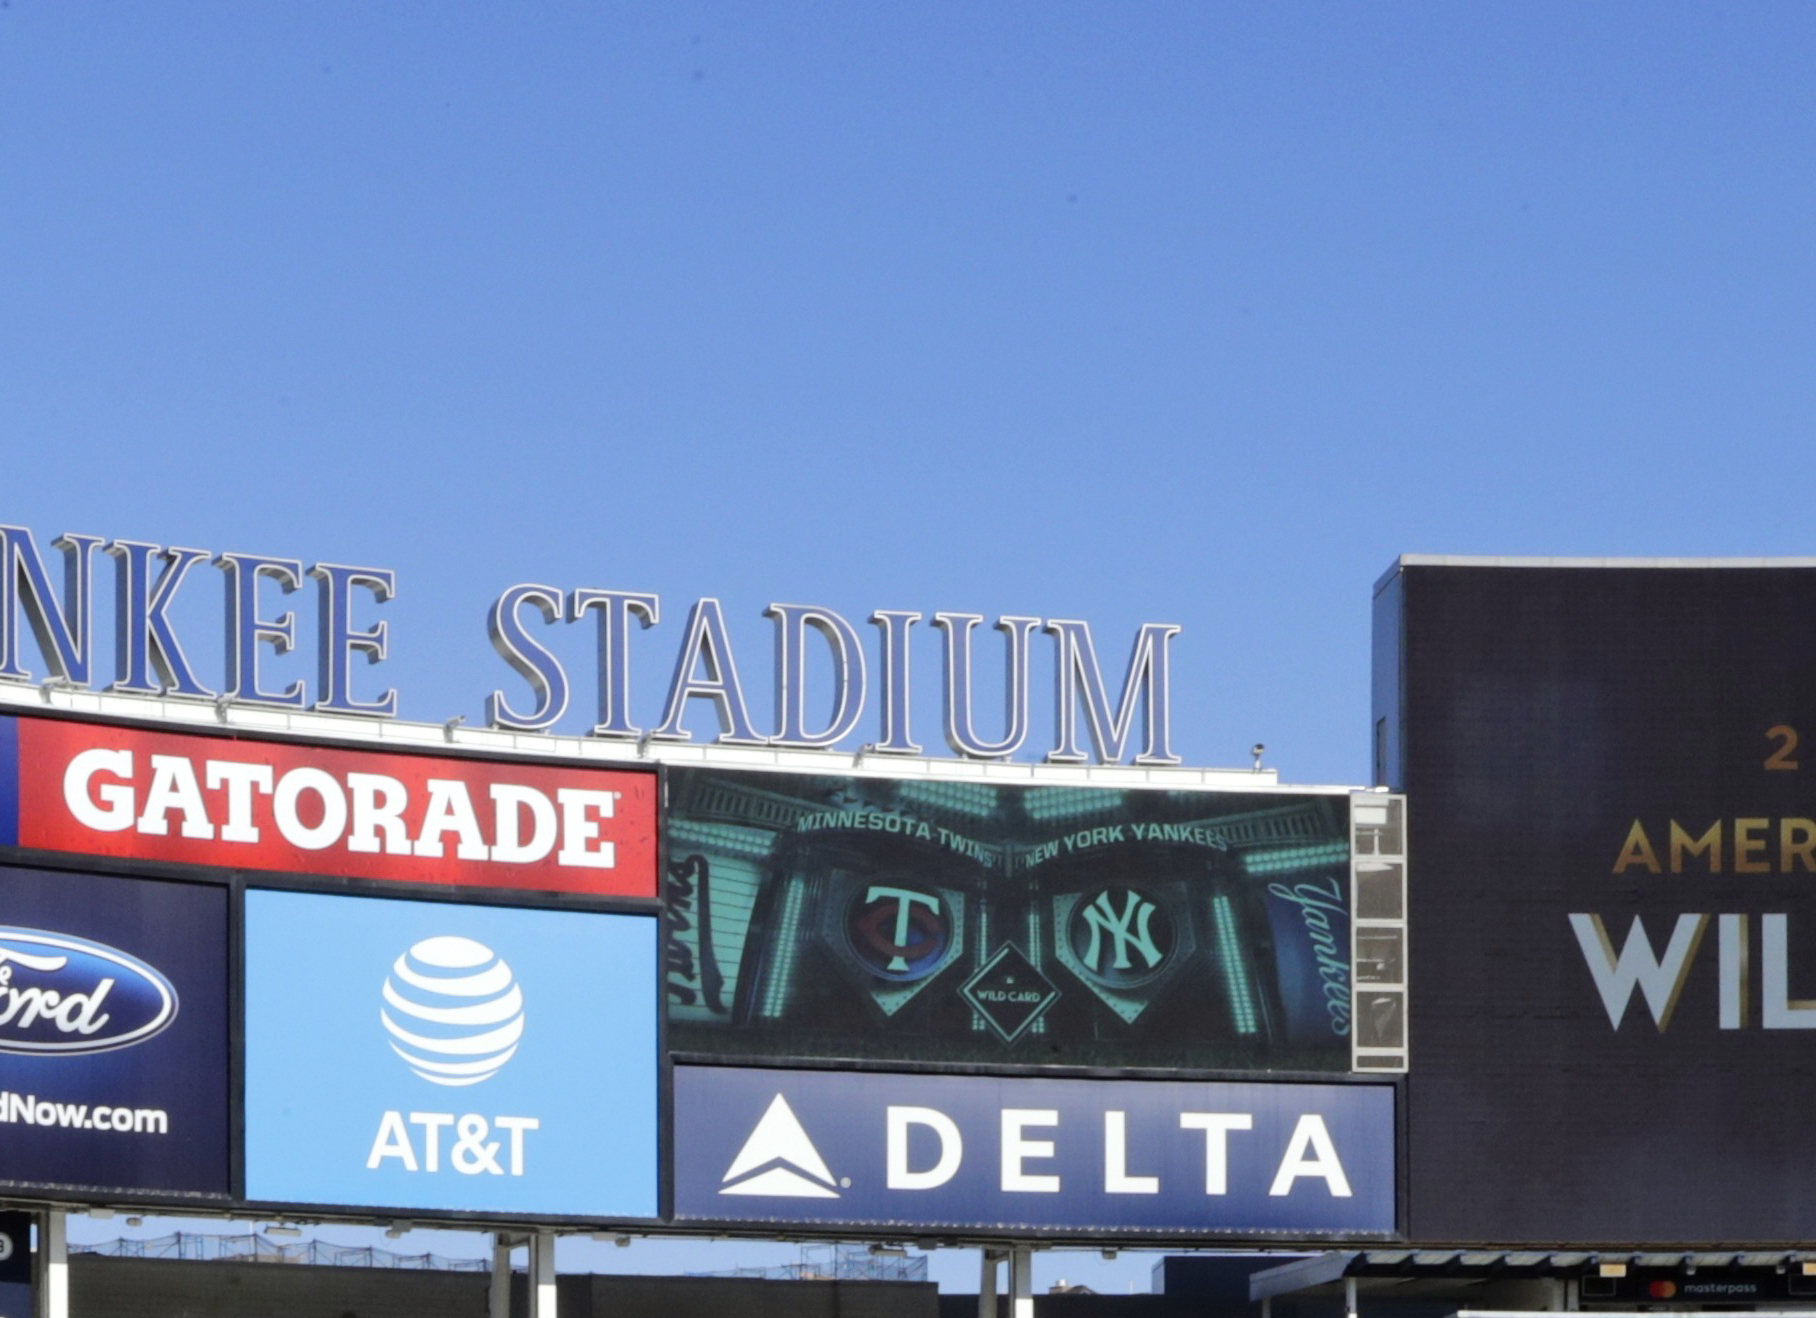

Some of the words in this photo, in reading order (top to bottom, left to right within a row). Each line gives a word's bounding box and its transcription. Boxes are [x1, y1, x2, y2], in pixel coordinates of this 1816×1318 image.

[487, 583, 1181, 765] STADIUM
[63, 749, 616, 868] GATORADE
[797, 811, 931, 840] MINNESOTA
[937, 828, 992, 868] TWINS
[1025, 840, 1059, 868] NEW
[1064, 825, 1124, 852] YORK
[1130, 824, 1228, 852] YANKEES
[977, 989, 1006, 1003] WILD
[1007, 989, 1041, 1003] CARD
[367, 1110, 539, 1176] AT&T
[887, 1104, 1353, 1198] DELTA
[1685, 1283, 1757, 1294] masterpass
